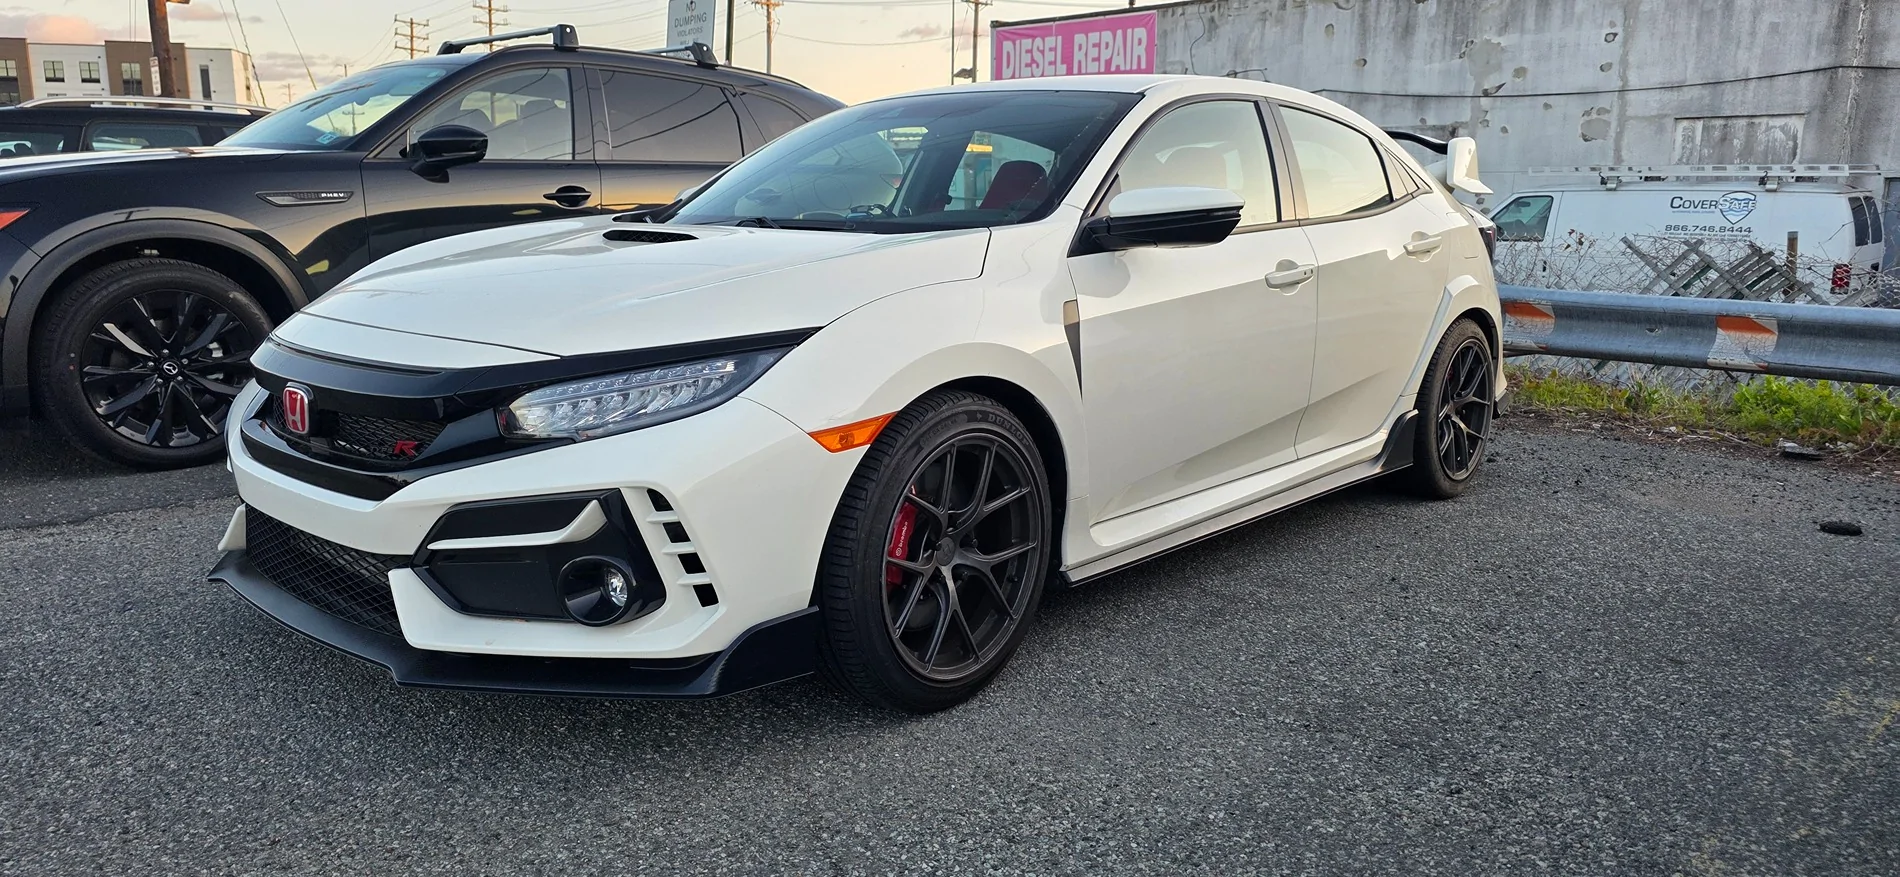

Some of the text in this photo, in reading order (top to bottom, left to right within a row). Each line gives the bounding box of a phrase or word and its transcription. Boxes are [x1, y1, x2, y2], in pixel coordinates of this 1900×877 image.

[686, 1, 696, 12] NO
[674, 12, 707, 28] DUMPING
[677, 26, 703, 37] VIOLATORS
[1002, 27, 1147, 79] DIESEL REPAIR
[1665, 224, 1752, 233] 866.746.8444
[988, 413, 1030, 446] DUNLOP
[393, 440, 419, 456] R
[898, 521, 908, 548] brembo
